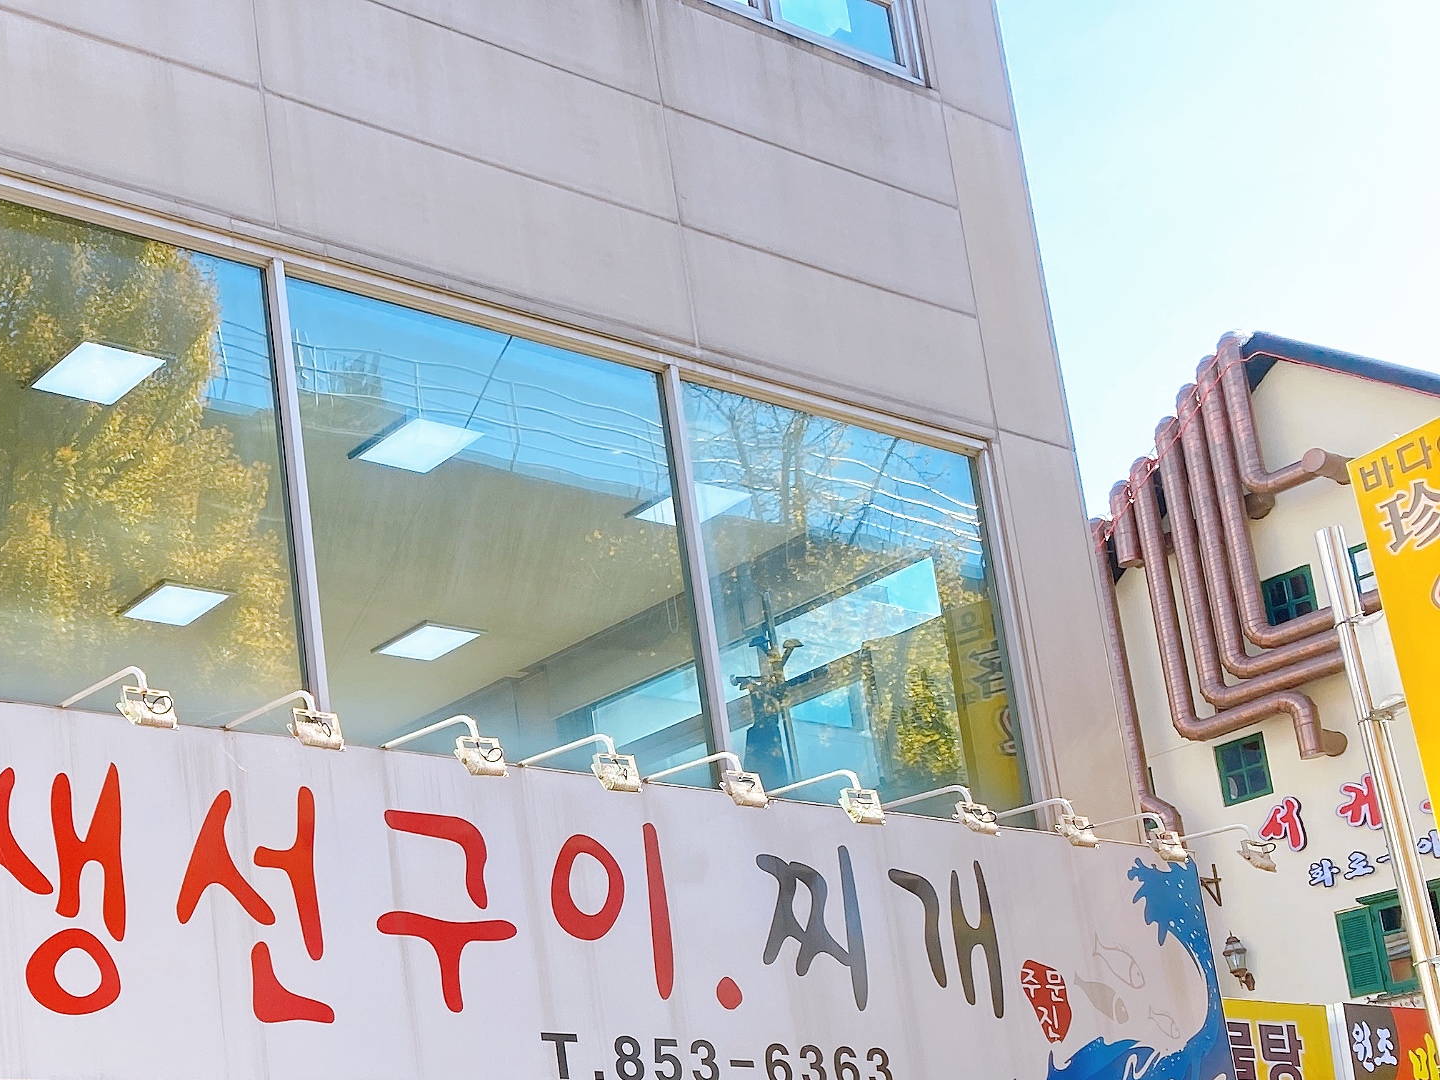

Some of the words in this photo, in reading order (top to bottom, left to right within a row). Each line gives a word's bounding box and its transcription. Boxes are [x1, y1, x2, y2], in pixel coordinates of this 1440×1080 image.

[1359, 436, 1440, 492] 바다
[756, 845, 1005, 1019] 찌개
[1352, 1020, 1398, 1073] 원조
